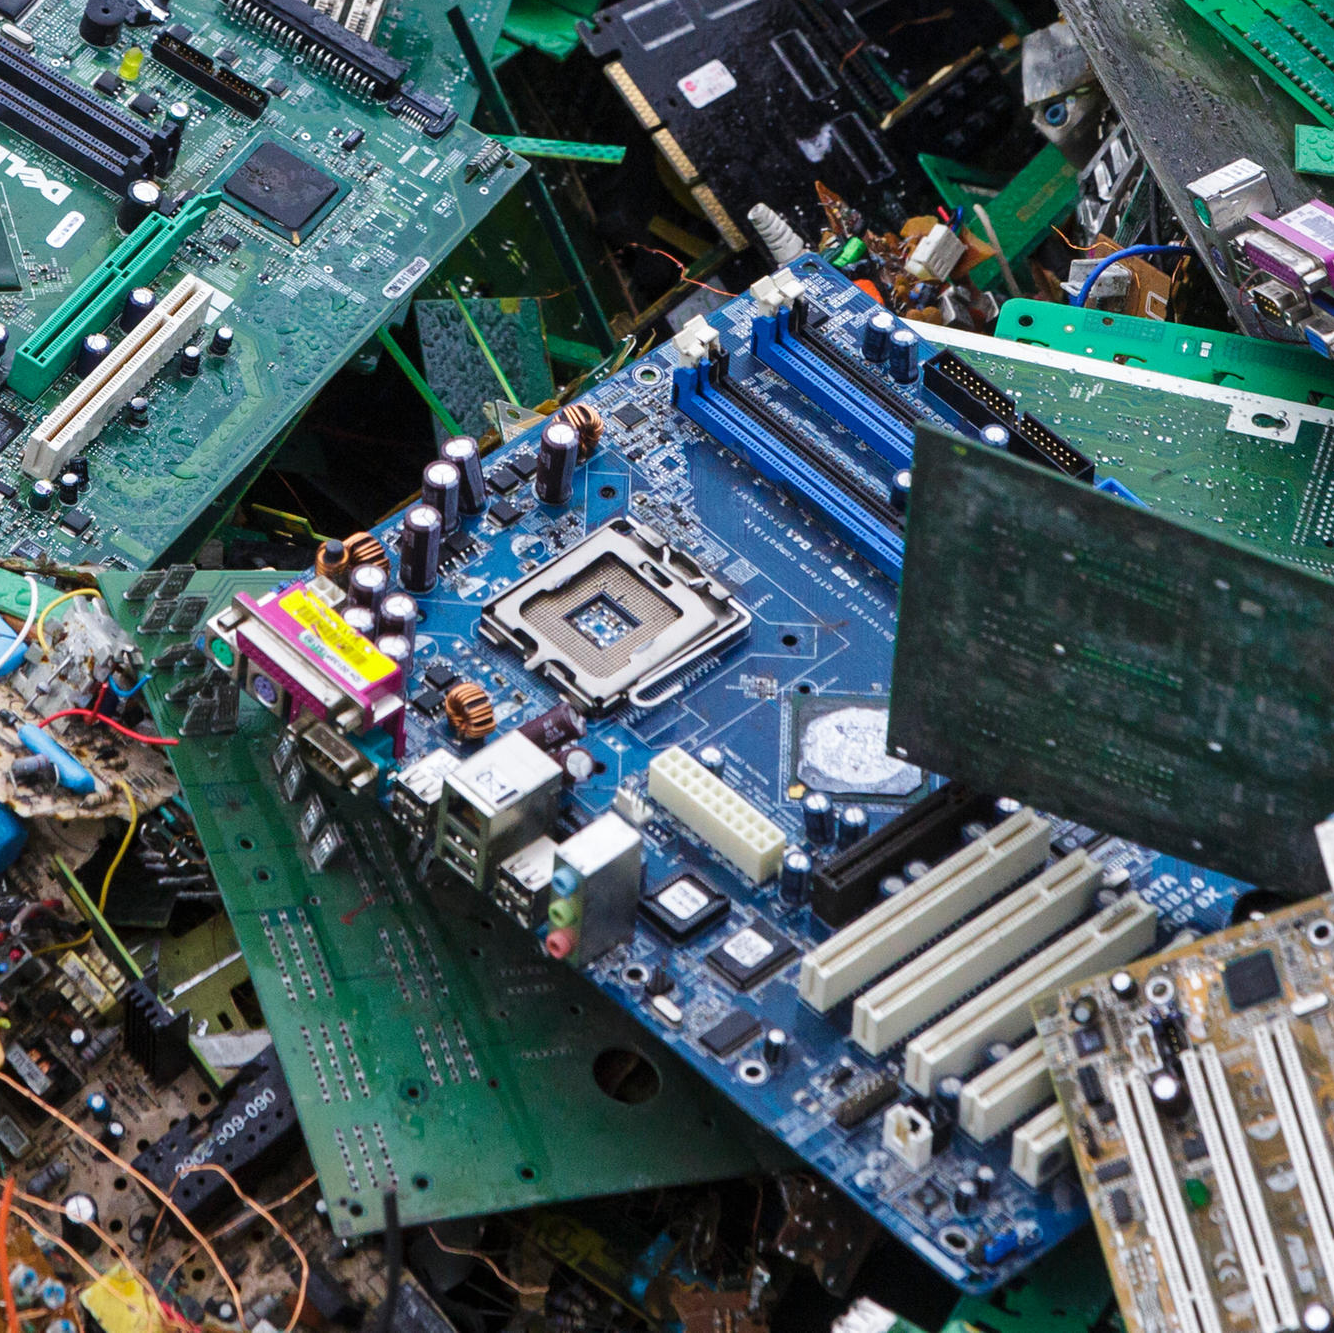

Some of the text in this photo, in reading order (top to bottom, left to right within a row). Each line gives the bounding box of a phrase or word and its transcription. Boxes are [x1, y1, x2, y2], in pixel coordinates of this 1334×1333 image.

[812, 548, 833, 568] and
[741, 516, 896, 644] Universal platform compatible
[1142, 874, 1180, 905] ATA
